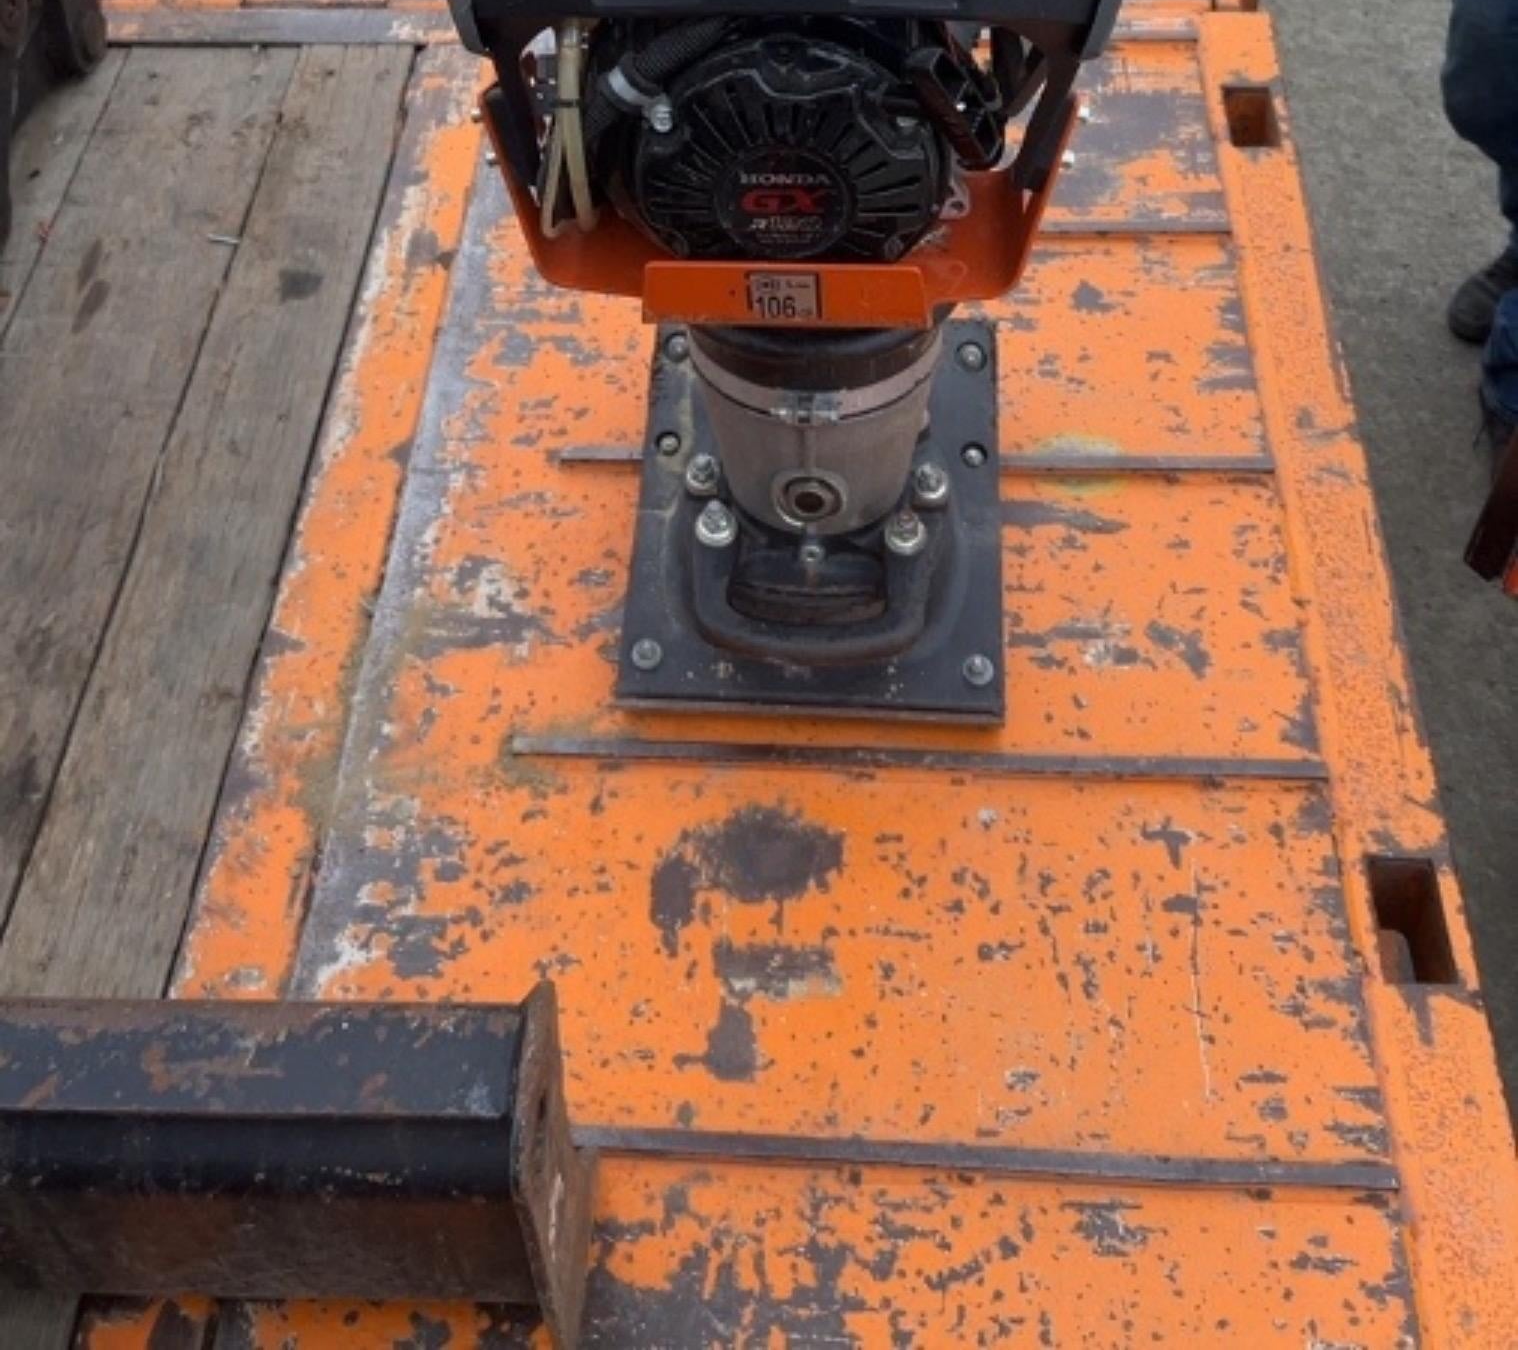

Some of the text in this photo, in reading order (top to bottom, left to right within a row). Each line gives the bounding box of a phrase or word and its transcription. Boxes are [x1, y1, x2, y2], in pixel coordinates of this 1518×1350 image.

[740, 172, 832, 185] HONDA
[741, 188, 835, 214] GX
[755, 295, 797, 319] 106
